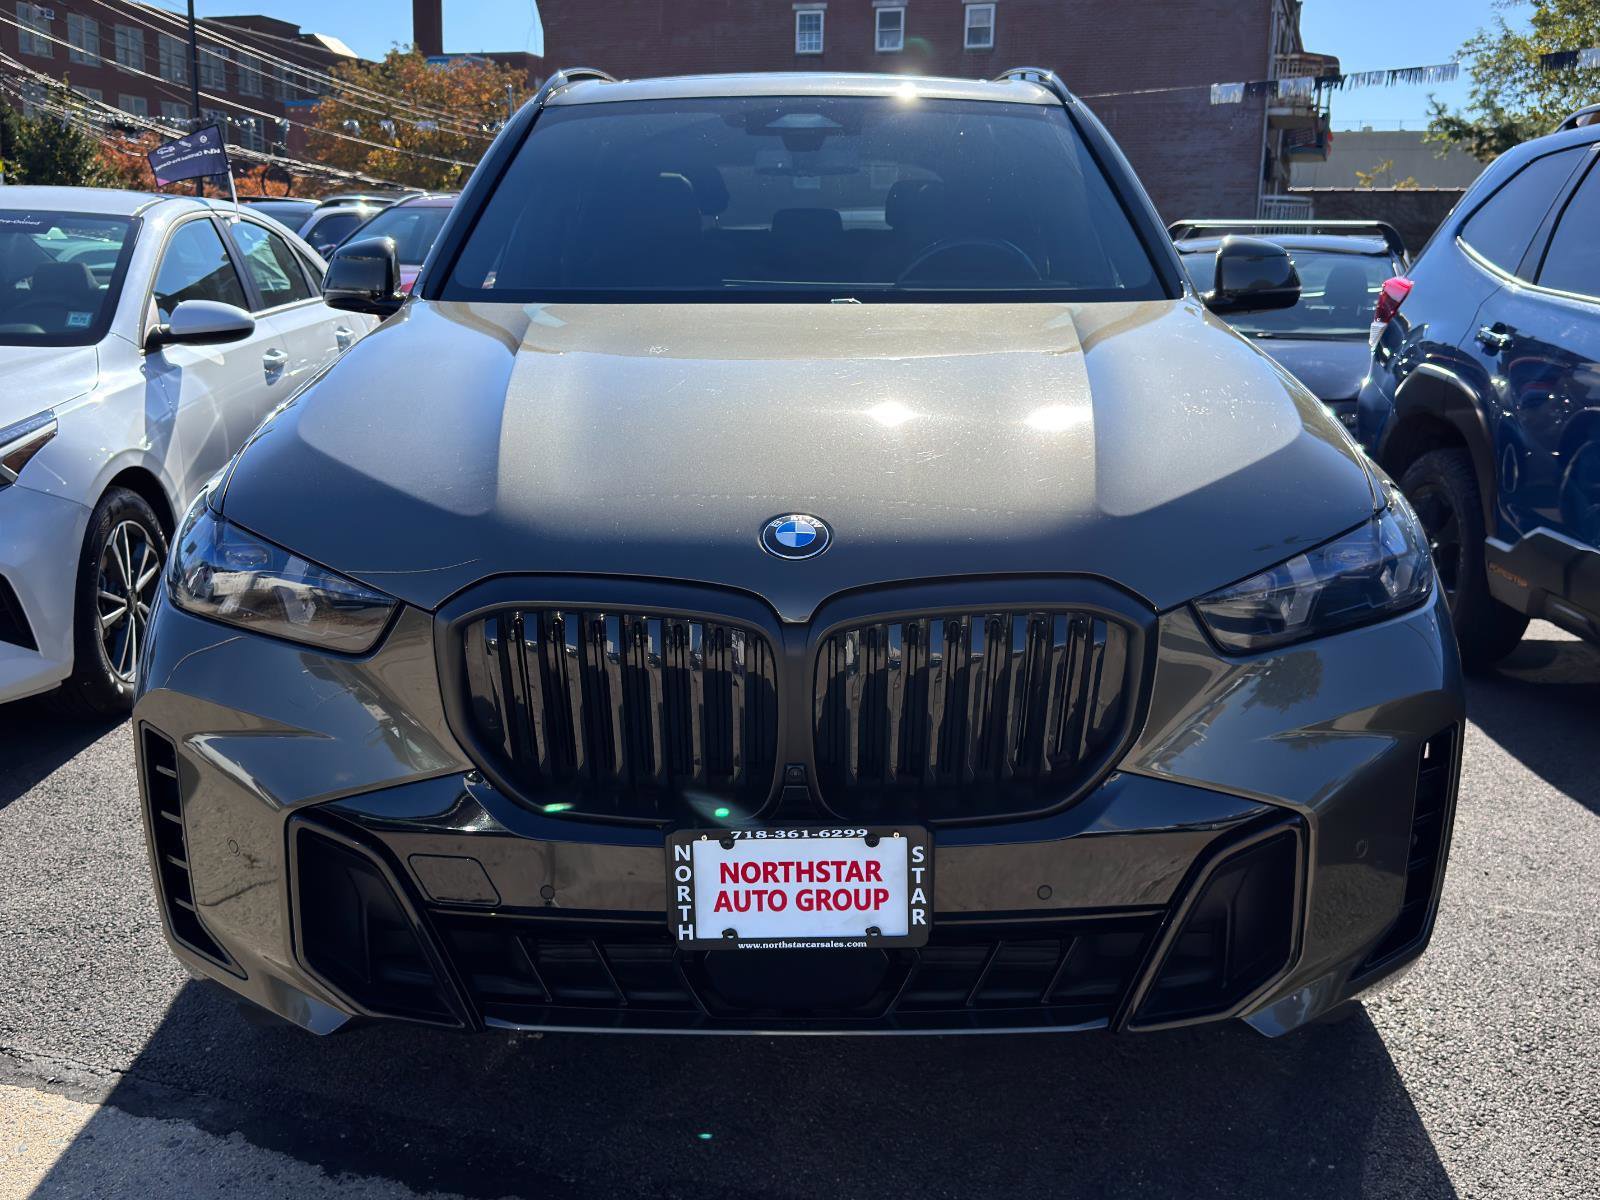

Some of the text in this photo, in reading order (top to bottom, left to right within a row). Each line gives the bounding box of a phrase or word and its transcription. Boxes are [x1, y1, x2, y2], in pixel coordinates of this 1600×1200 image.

[730, 828, 869, 840] 718-361-6299
[719, 860, 883, 883] NORTHSTAR
[674, 844, 694, 940] NORTH
[911, 846, 926, 926] STAR
[713, 888, 890, 913] AUTO GROUP
[737, 940, 868, 950] www.northstarcarsales.com
